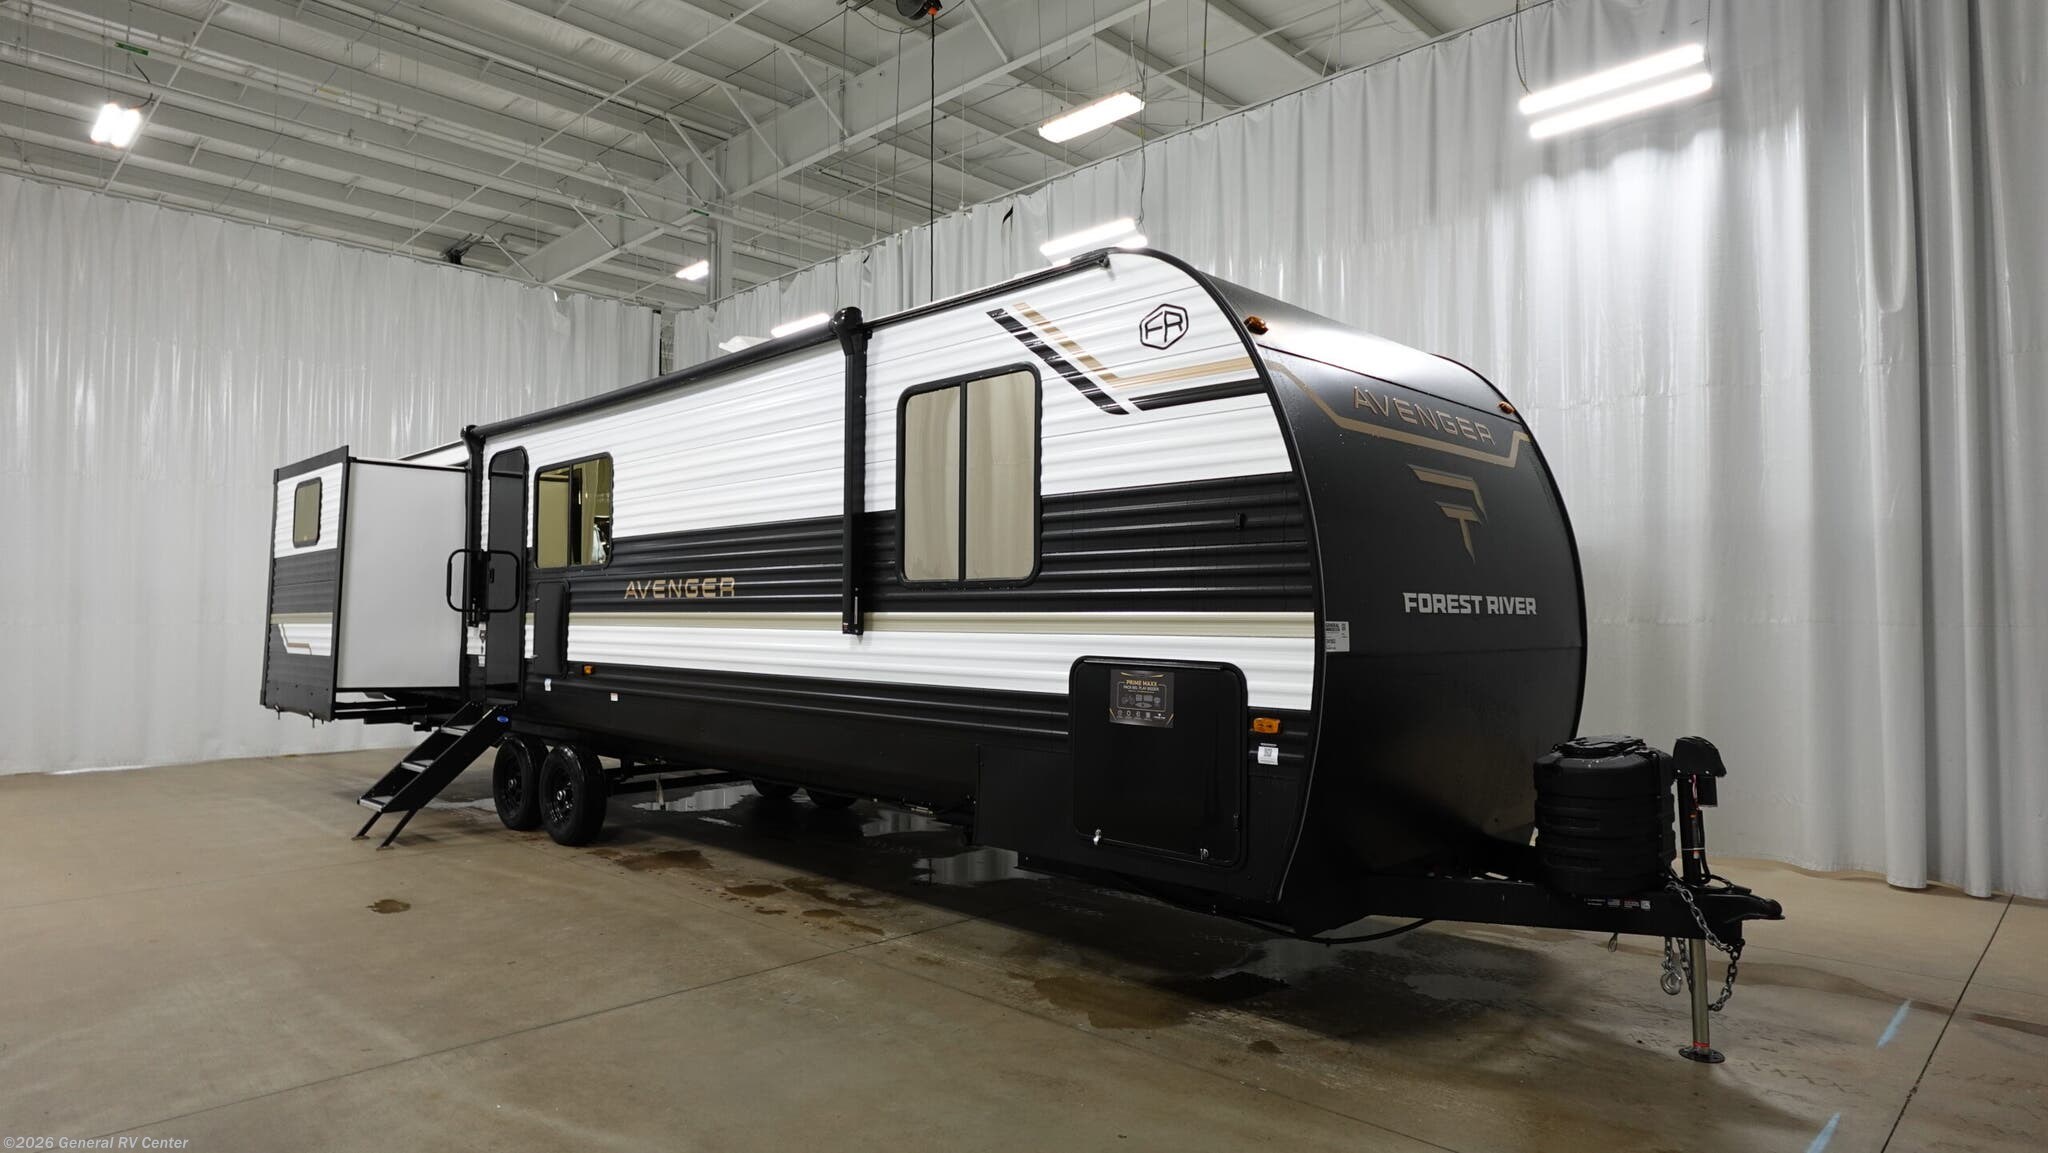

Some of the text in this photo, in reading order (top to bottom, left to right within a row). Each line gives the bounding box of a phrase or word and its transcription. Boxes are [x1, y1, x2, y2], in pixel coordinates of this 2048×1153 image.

[1353, 386, 1495, 445] AVENGER
[624, 577, 735, 599] AVENGER
[1403, 592, 1537, 615] FOREST RIVER
